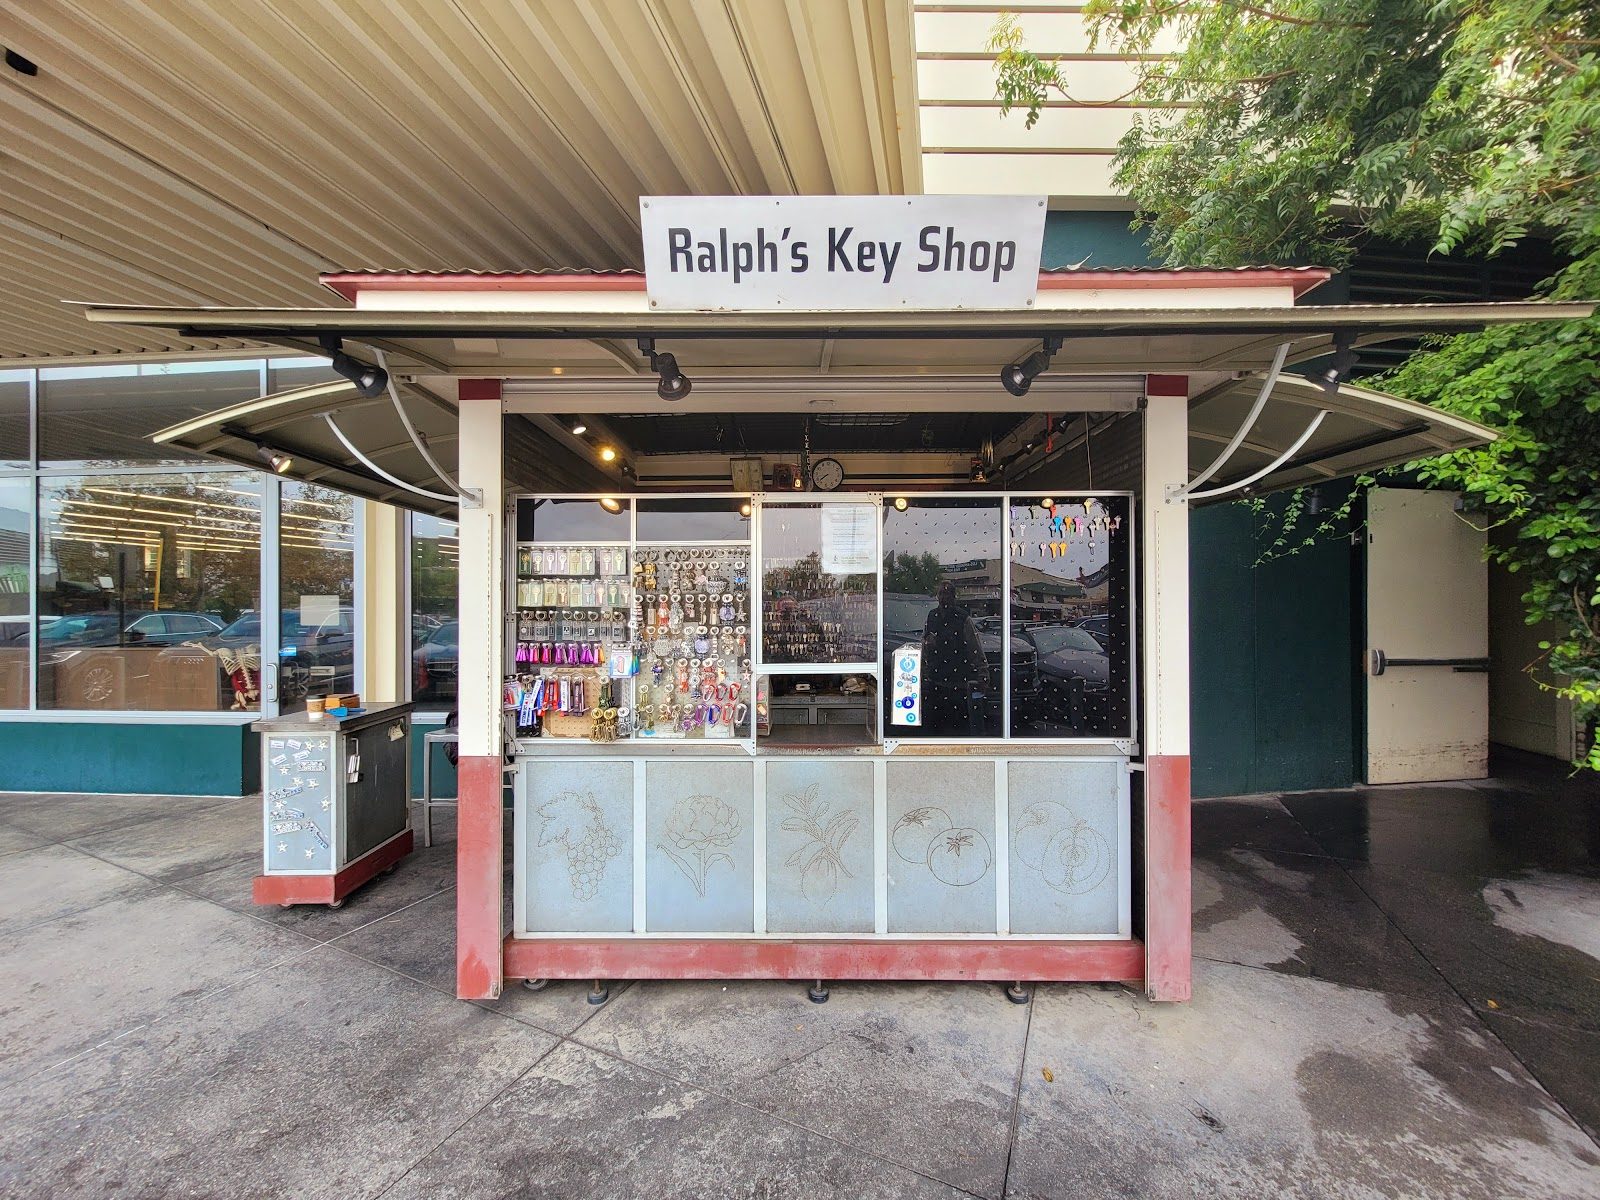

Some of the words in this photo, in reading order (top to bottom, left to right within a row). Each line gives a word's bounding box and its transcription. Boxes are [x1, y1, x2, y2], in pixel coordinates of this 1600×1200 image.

[668, 227, 809, 284] Ralph's
[827, 227, 902, 284] Key
[917, 225, 1016, 283] Shop
